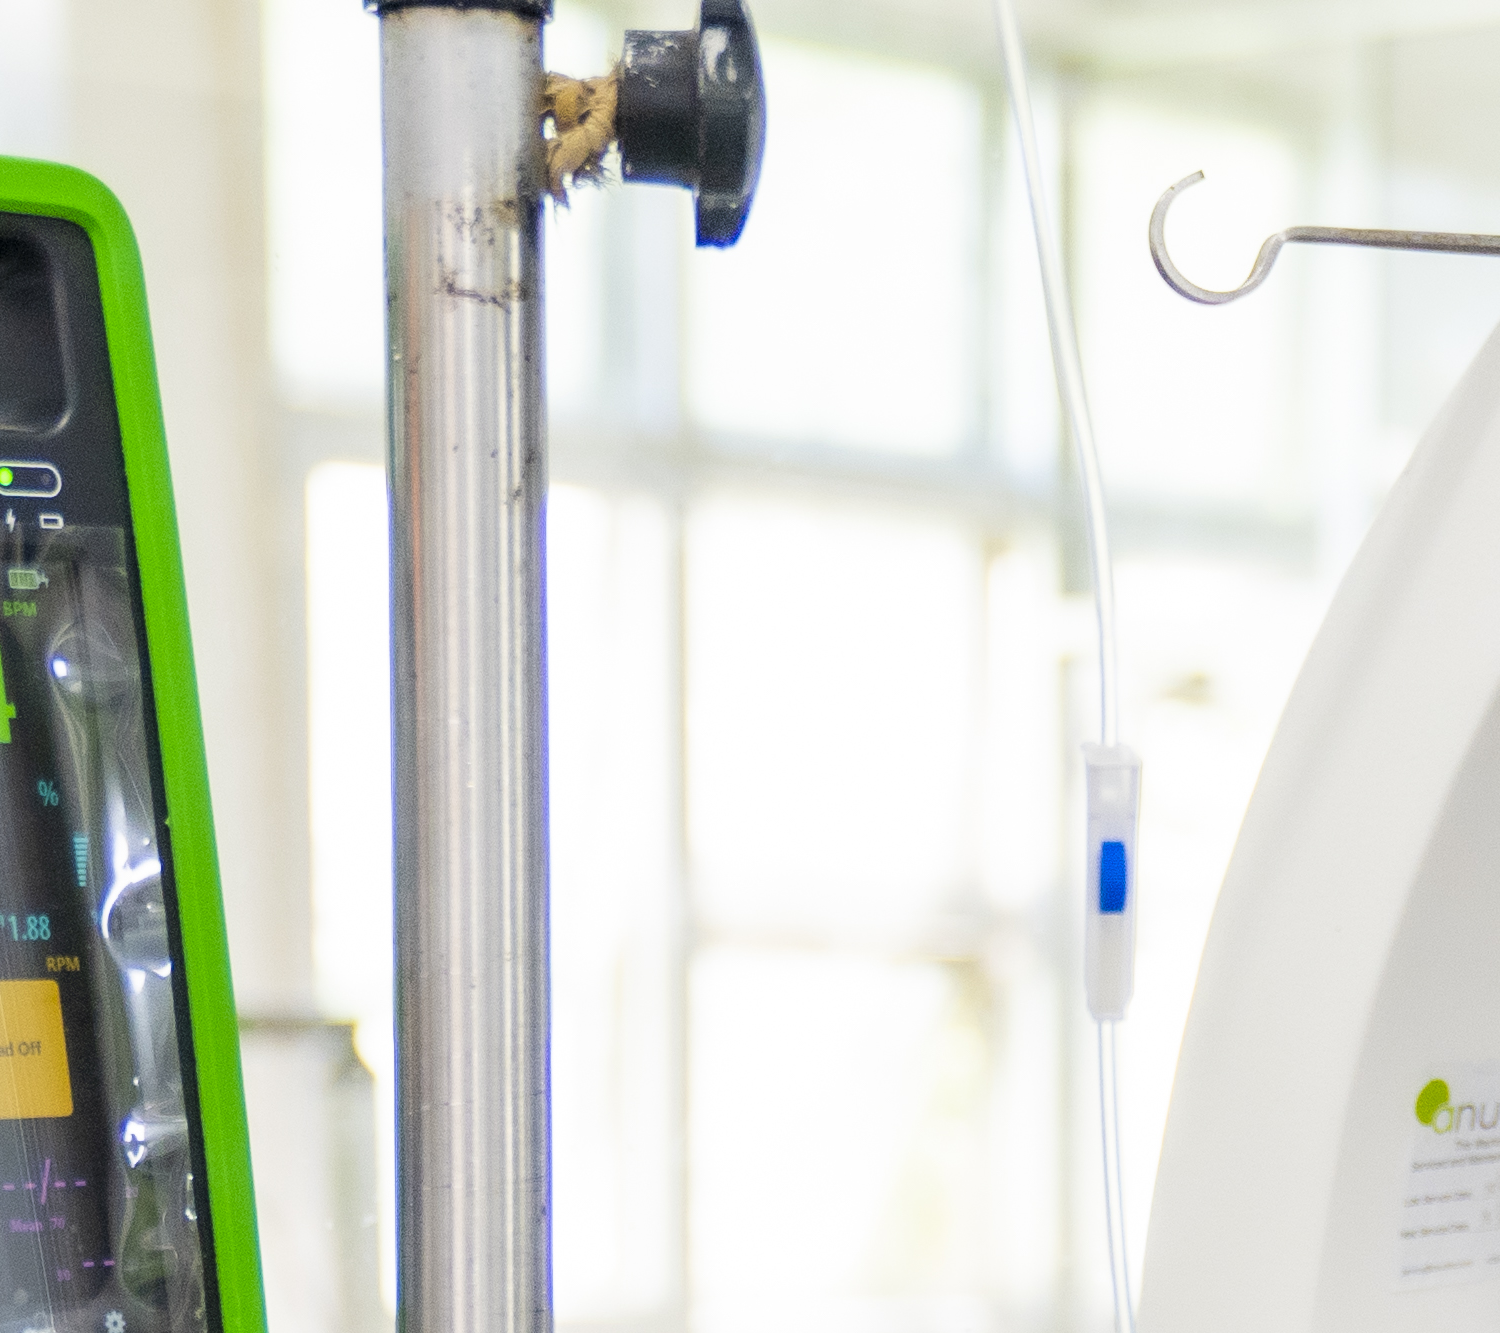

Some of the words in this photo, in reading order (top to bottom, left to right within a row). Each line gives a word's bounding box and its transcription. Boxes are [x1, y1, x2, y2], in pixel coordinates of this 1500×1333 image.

[3, 600, 37, 617] BPM
[37, 778, 59, 807] %
[7, 913, 52, 942] 1.88
[46, 955, 80, 972] RPM
[18, 1040, 42, 1056] Off
